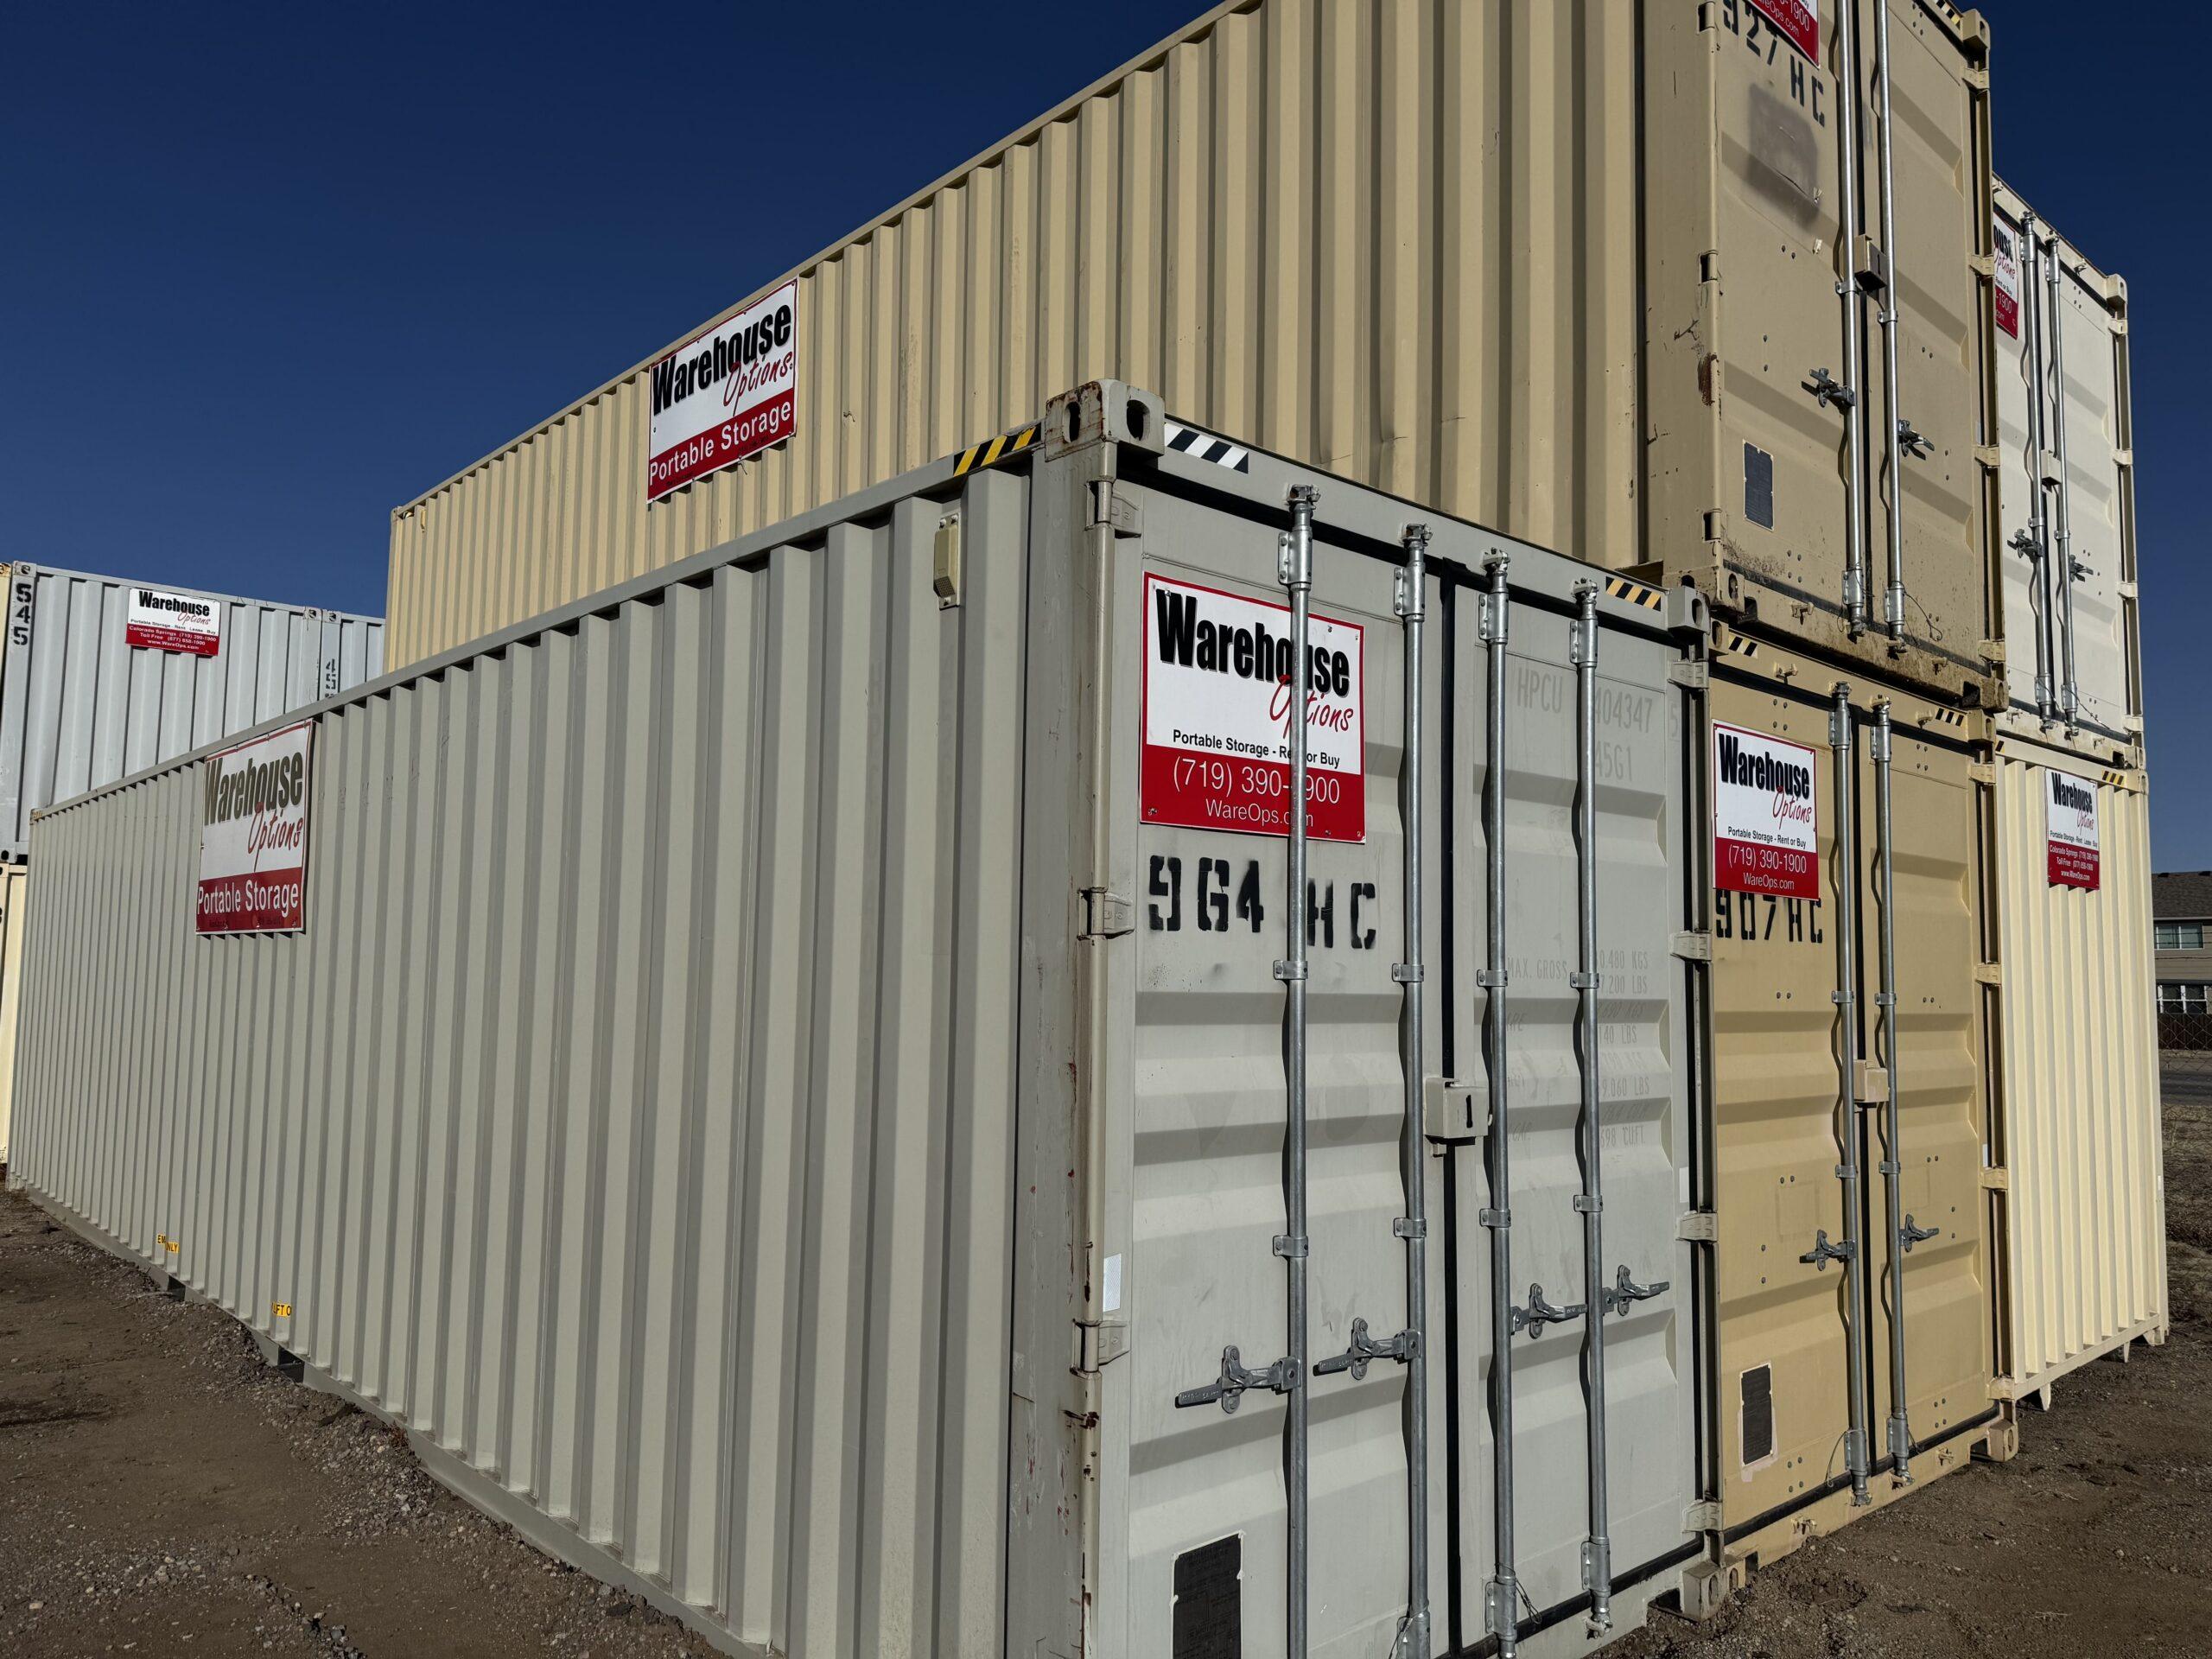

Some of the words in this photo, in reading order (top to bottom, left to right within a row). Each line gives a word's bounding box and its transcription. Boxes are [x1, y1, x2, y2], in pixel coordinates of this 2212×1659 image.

[652, 304, 791, 416] Warehouse
[723, 350, 793, 417] Options
[650, 438, 714, 486] Portable
[721, 401, 791, 450] Storage
[139, 590, 210, 617] Warehouse
[177, 612, 211, 626] Options
[1516, 666, 1563, 714] HPCU
[1173, 729, 1223, 749] Portable
[1226, 737, 1269, 759] Storage
[1320, 752, 1340, 770] Buy
[1719, 733, 1810, 800] Warehouse
[204, 752, 303, 826] Warehouse
[1173, 755, 1233, 798] (719)
[1241, 766, 1340, 804] 390-900
[2051, 772, 2093, 814] Warehouse
[1205, 798, 1313, 828] WareOps.cm
[1773, 787, 1812, 830] Options
[2076, 810, 2094, 836] Options
[248, 804, 303, 874] Options
[1728, 826, 1751, 839] Portable
[1752, 830, 1774, 844] Storage
[1777, 835, 1789, 845] Rent
[1796, 837, 1807, 849] Buy
[1729, 843, 1757, 871] (719)
[1759, 849, 1807, 874] 390-1900
[2050, 844, 2066, 855] Colorado
[197, 883, 241, 916] Portable
[245, 879, 299, 918] Storage
[1743, 872, 1795, 890] WareOps.com
[1715, 888, 1777, 941] 907
